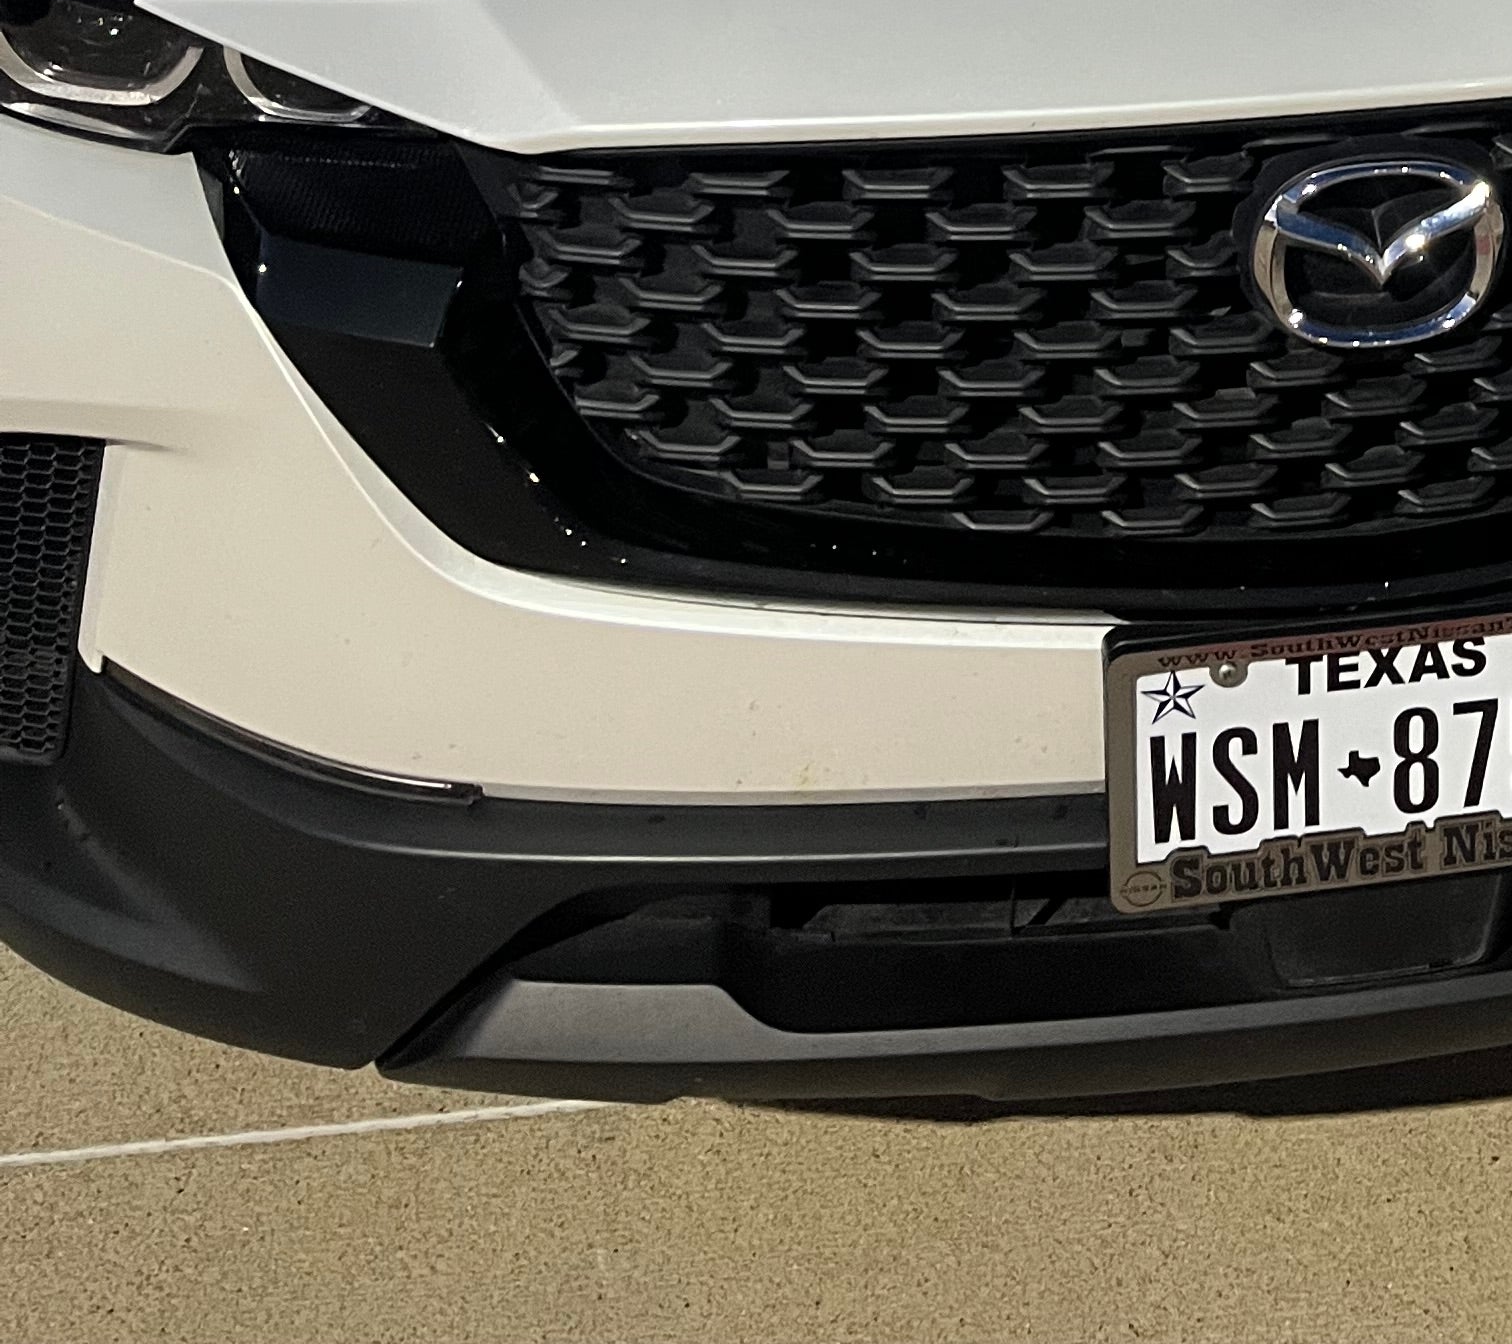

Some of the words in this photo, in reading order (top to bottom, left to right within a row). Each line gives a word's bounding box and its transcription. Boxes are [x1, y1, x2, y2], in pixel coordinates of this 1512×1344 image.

[1285, 636, 1487, 696] TEXAS
[1149, 719, 1320, 845] WSM
[1172, 831, 1424, 900] SouthWest
